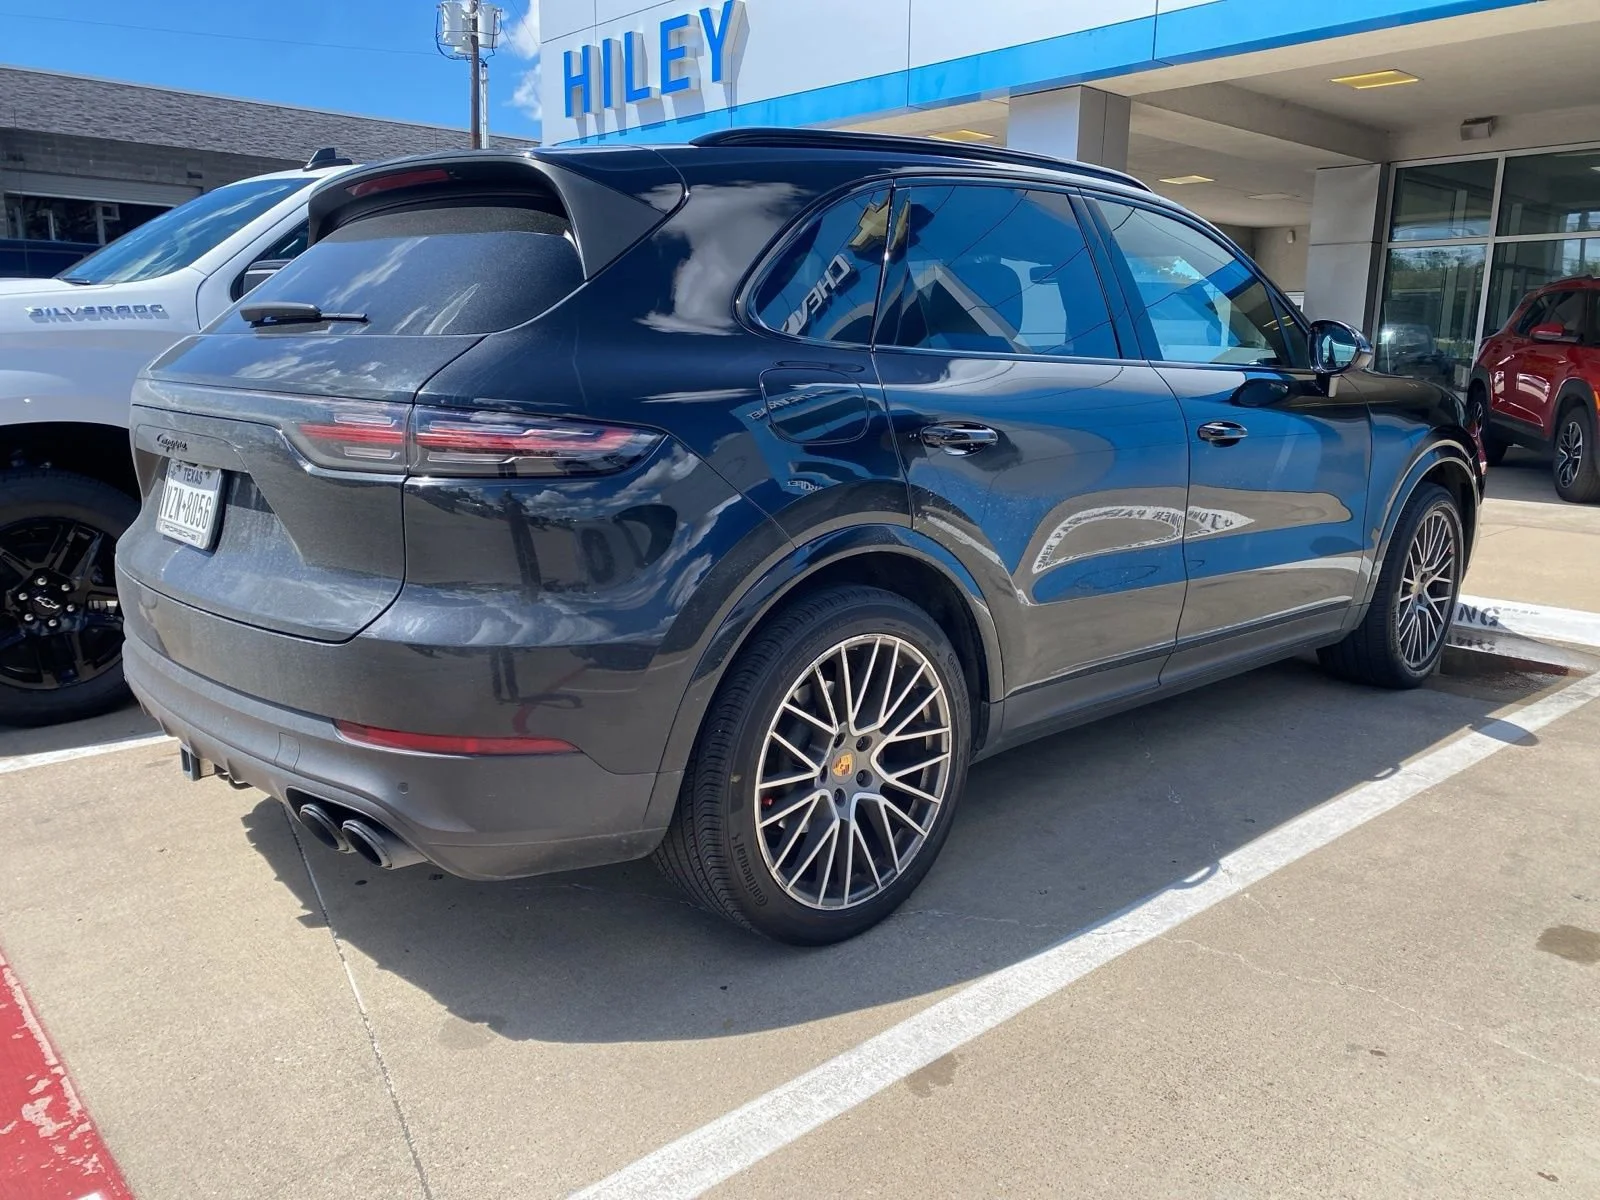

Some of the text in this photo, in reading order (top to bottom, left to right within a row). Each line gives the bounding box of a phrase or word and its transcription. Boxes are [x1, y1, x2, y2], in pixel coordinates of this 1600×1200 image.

[563, 0, 740, 119] HILEY
[26, 303, 165, 321] SILVERADO
[183, 466, 203, 485] TEXAS
[1457, 603, 1502, 627] NG
[733, 842, 769, 907] Continental
